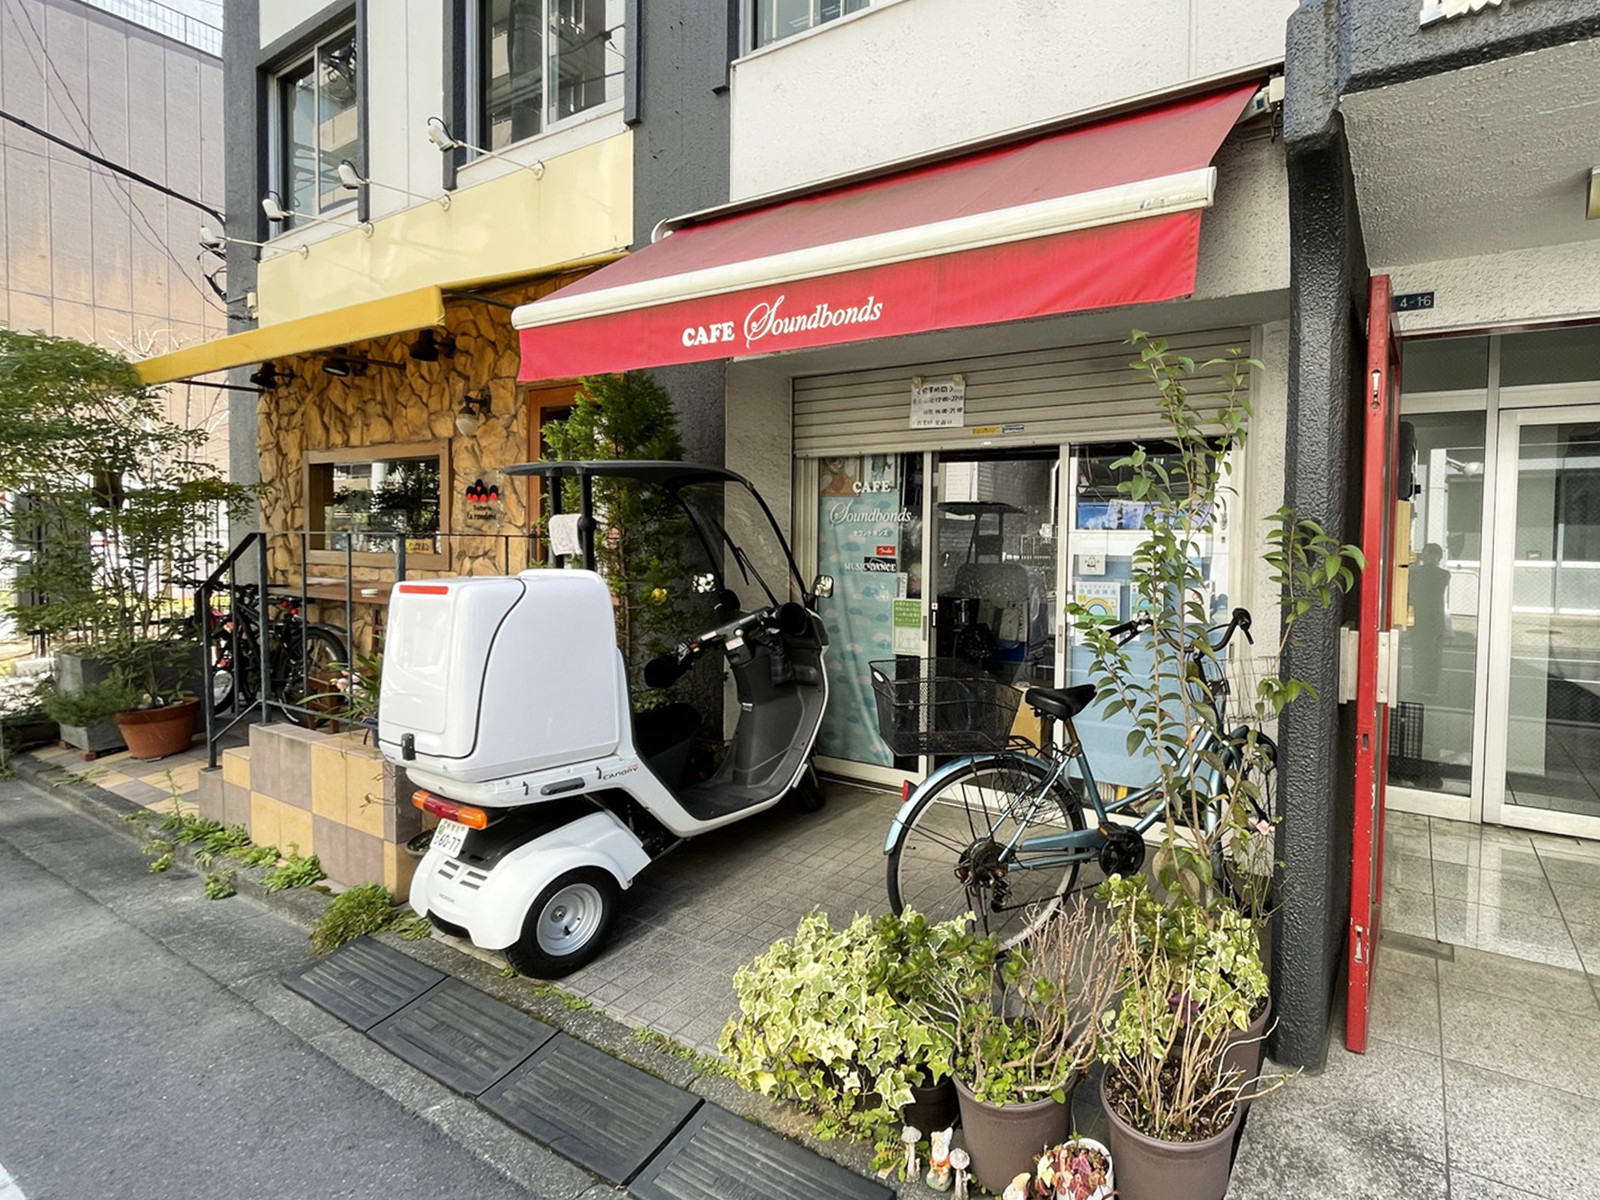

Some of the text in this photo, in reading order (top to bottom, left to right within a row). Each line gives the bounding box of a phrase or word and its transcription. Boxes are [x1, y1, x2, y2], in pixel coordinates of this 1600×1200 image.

[1399, 295, 1432, 308] 4-16
[682, 295, 883, 349] CAFE Soundbonds
[852, 480, 892, 494] CAFE
[829, 497, 912, 528] Soundbonds
